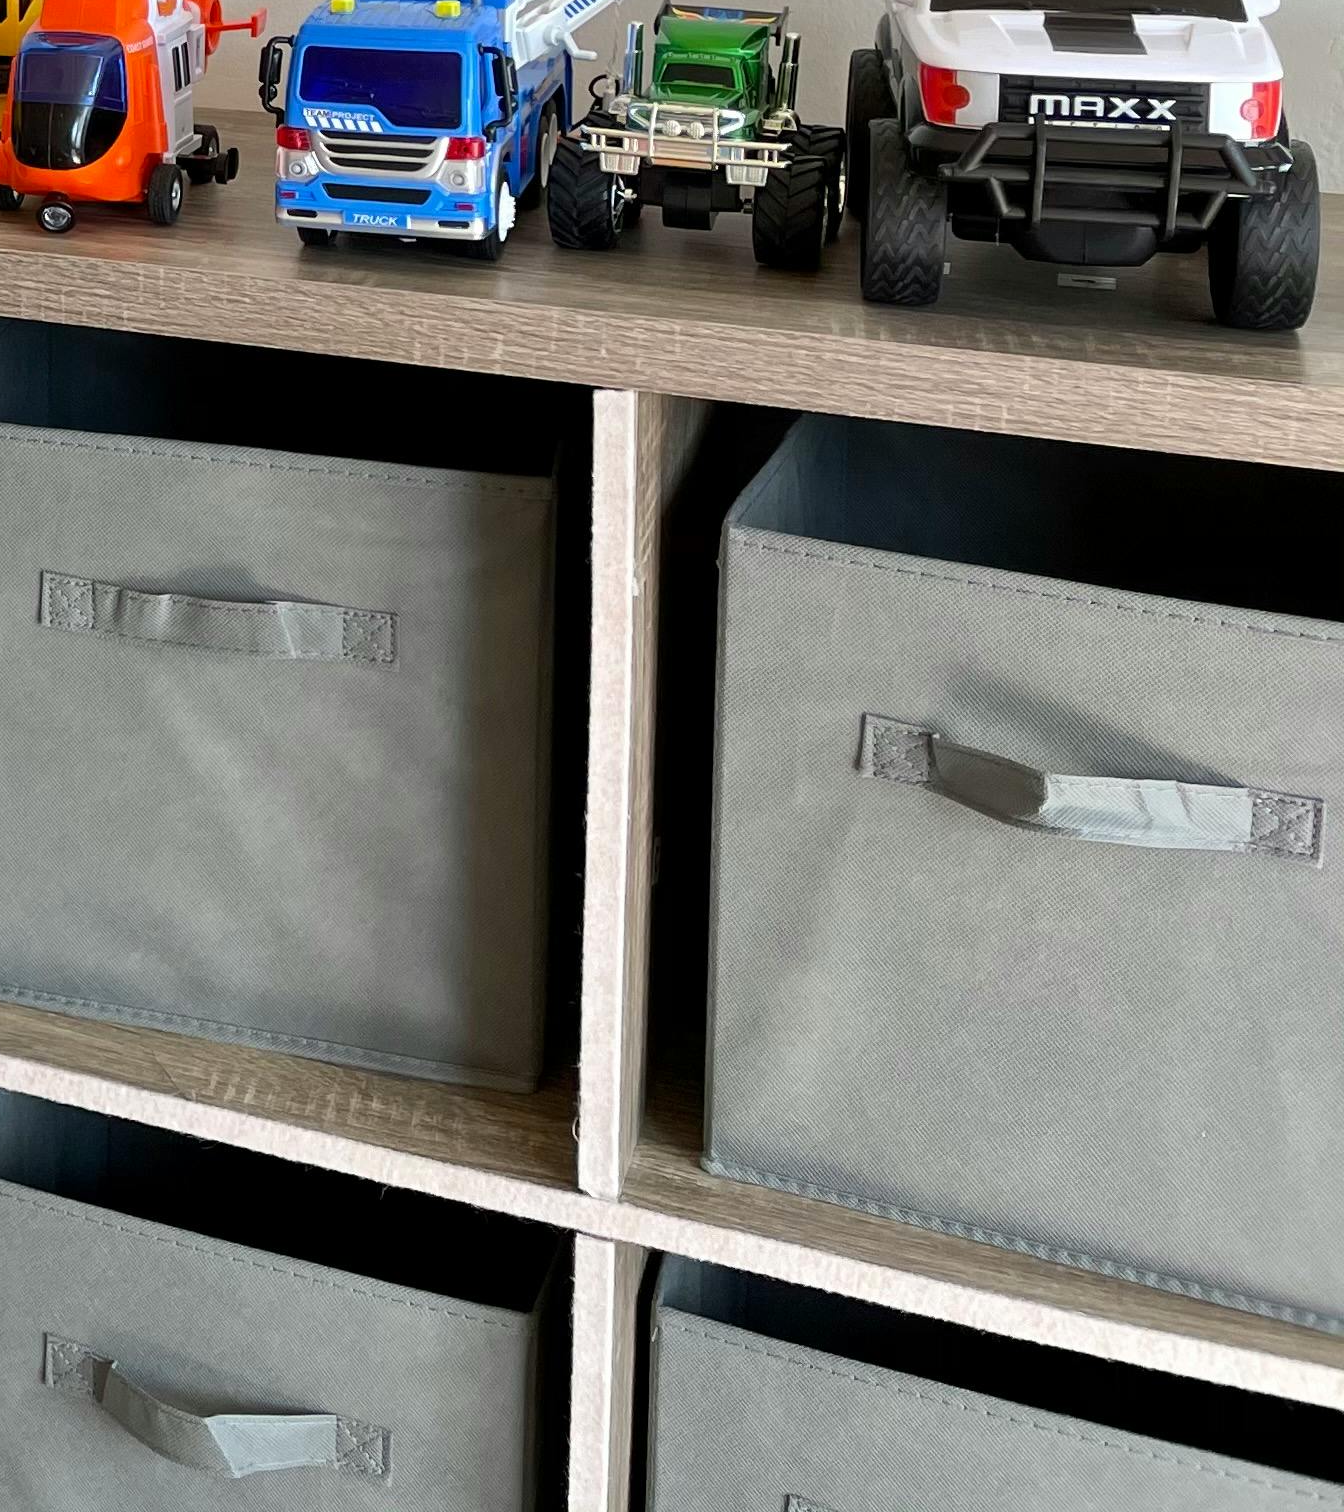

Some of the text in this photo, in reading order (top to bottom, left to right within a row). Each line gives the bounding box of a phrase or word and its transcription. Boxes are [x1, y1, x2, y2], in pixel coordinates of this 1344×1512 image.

[1029, 94, 1177, 121] MAXX
[332, 111, 375, 121] PROJECT
[353, 213, 399, 226] TRUCK
